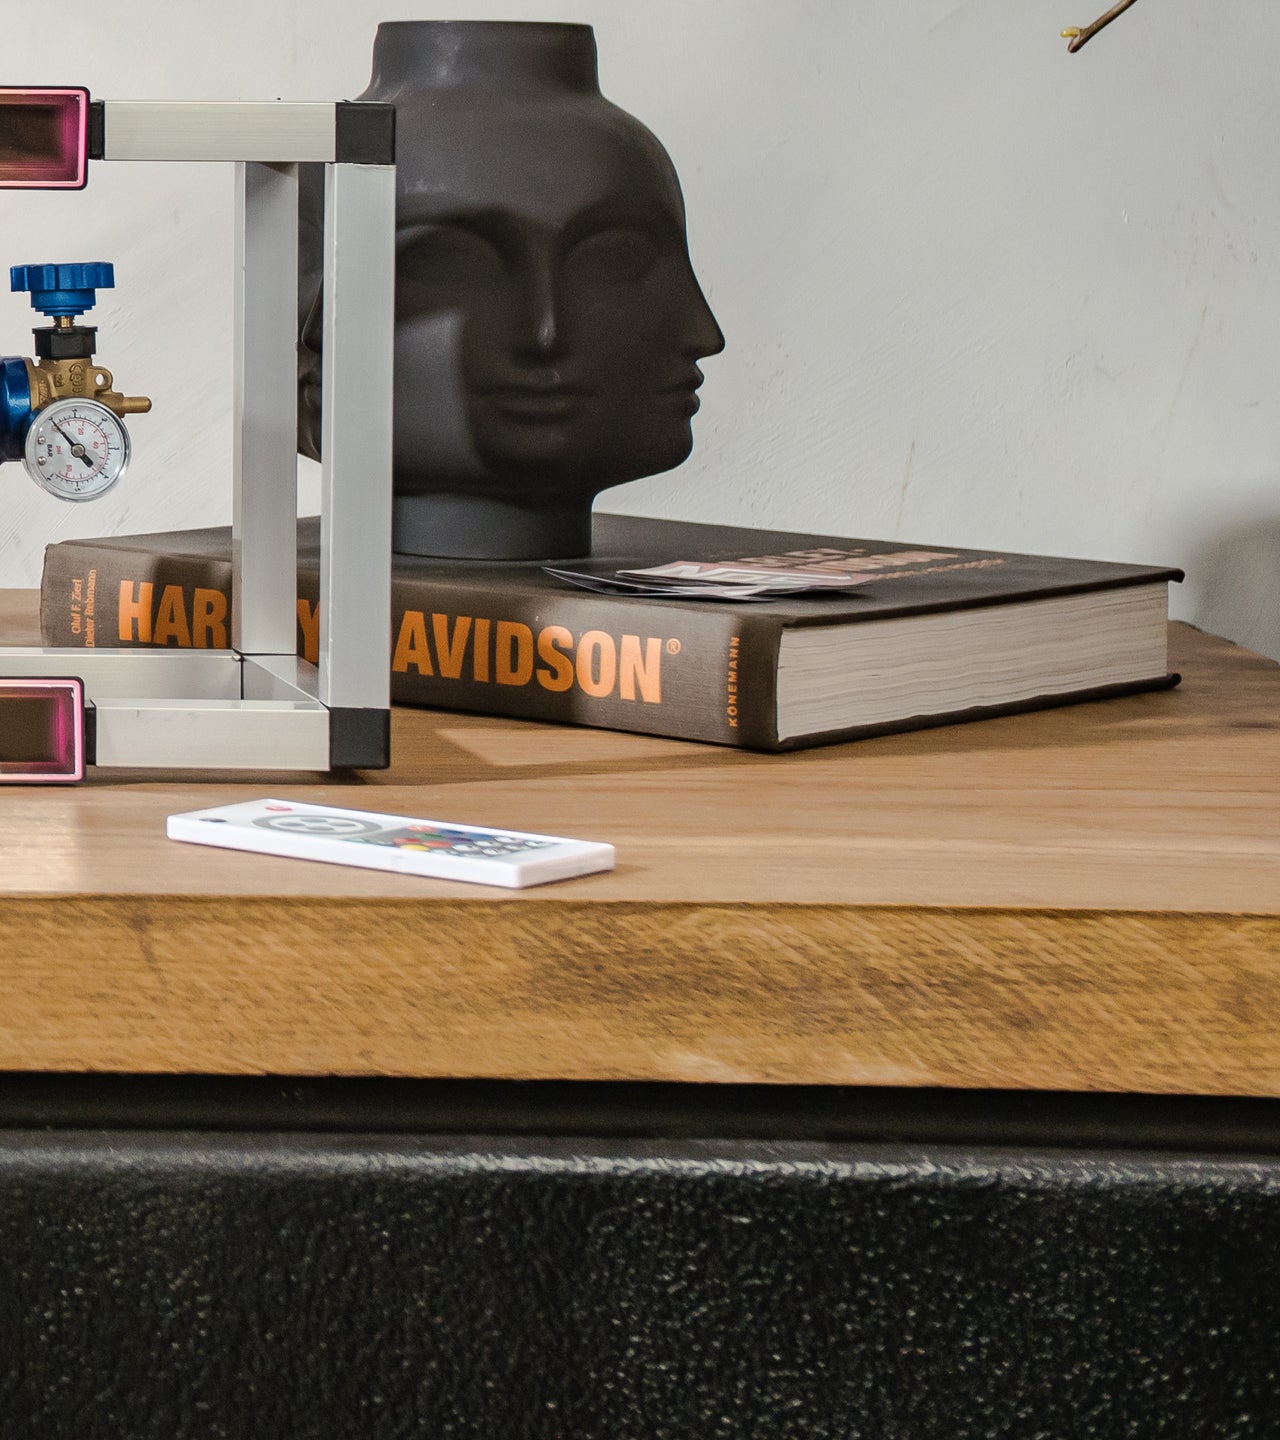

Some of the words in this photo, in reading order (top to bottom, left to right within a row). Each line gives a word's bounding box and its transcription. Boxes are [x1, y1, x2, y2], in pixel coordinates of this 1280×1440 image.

[71, 578, 82, 601] Zierl
[85, 569, 97, 616] Rebmann
[71, 603, 81, 611] F.
[118, 580, 320, 664] HARY
[71, 613, 82, 634] Oluf
[85, 618, 96, 648] Dieter
[726, 636, 740, 728] KÖNEMANN
